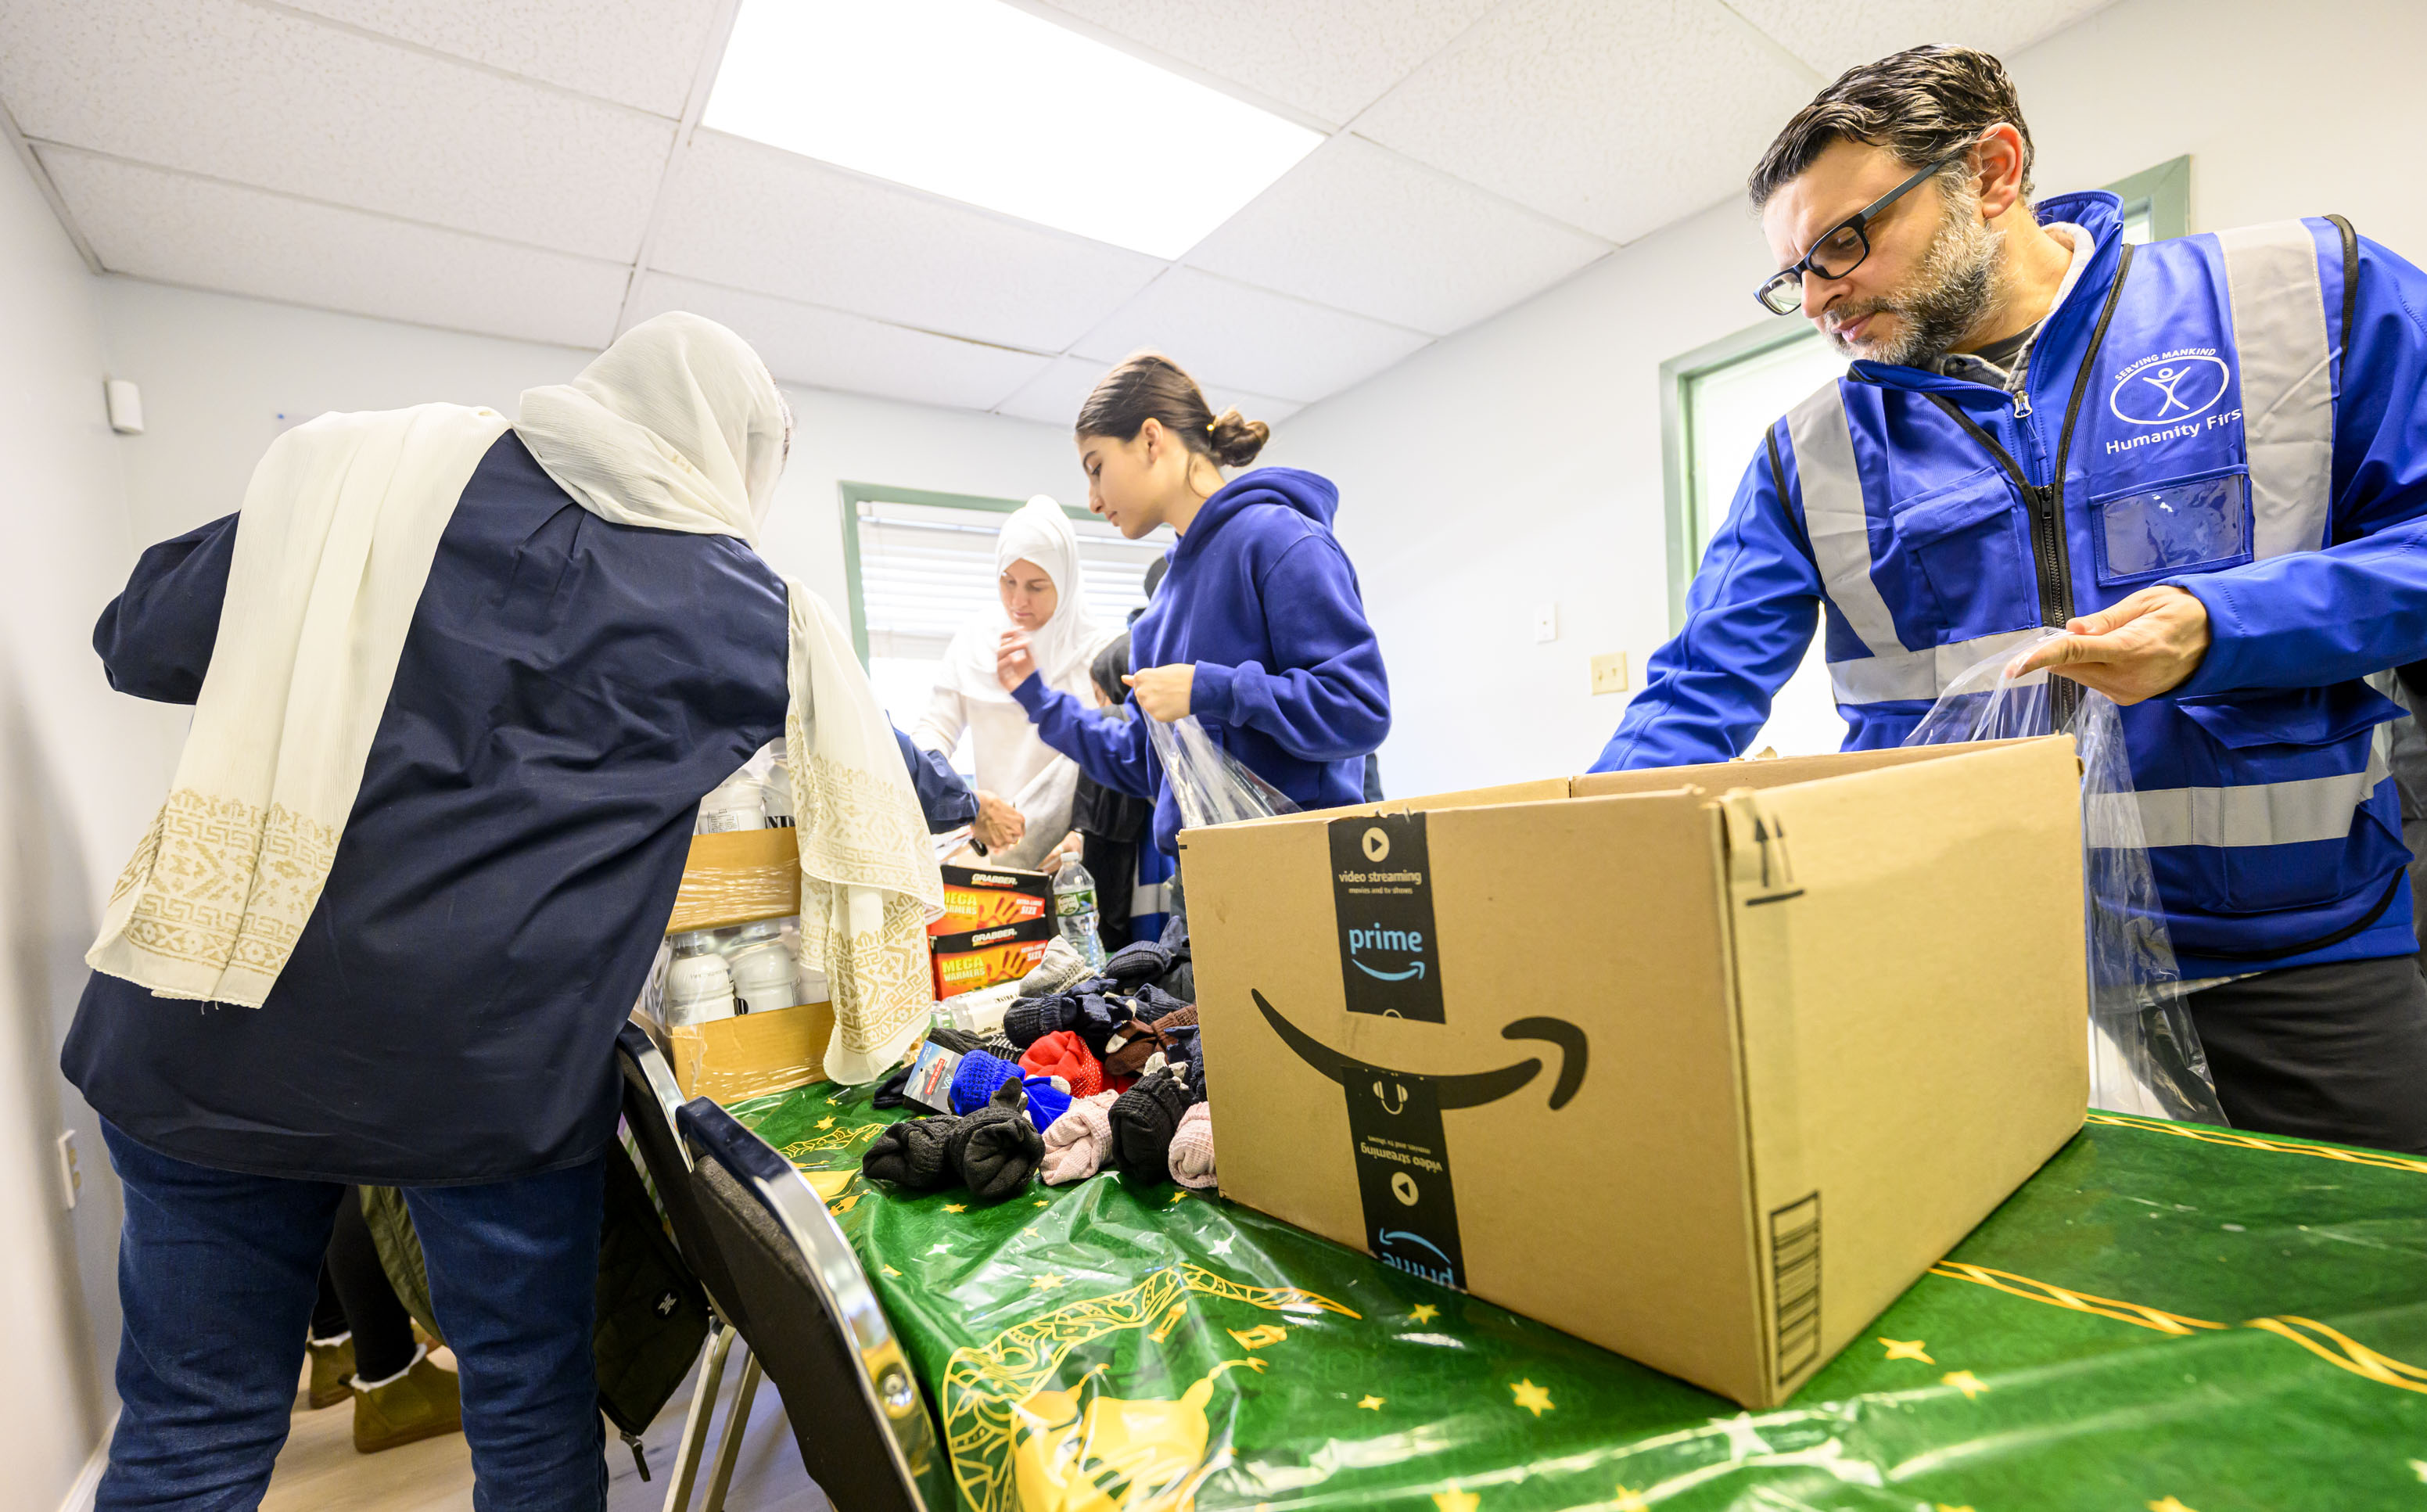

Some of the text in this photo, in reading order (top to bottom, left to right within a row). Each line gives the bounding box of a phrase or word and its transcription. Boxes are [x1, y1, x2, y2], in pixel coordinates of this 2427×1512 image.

[2115, 348, 2216, 381] SERVING MANKIND
[2106, 408, 2242, 454] Humanity Firs
[971, 874, 1018, 885] GRABBER
[1338, 869, 1422, 885] video streaming
[1348, 885, 1371, 894] movies
[1392, 885, 1413, 894] shows
[944, 904, 977, 915] ARMERS
[1020, 906, 1037, 915] SIZE
[971, 928, 1018, 943] GRABBER
[1348, 921, 1424, 955] prime
[1023, 950, 1042, 961] SIZE
[942, 955, 984, 974] MEGA
[944, 967, 986, 982] WARMERS
[1360, 1141, 1443, 1173] video streaming
